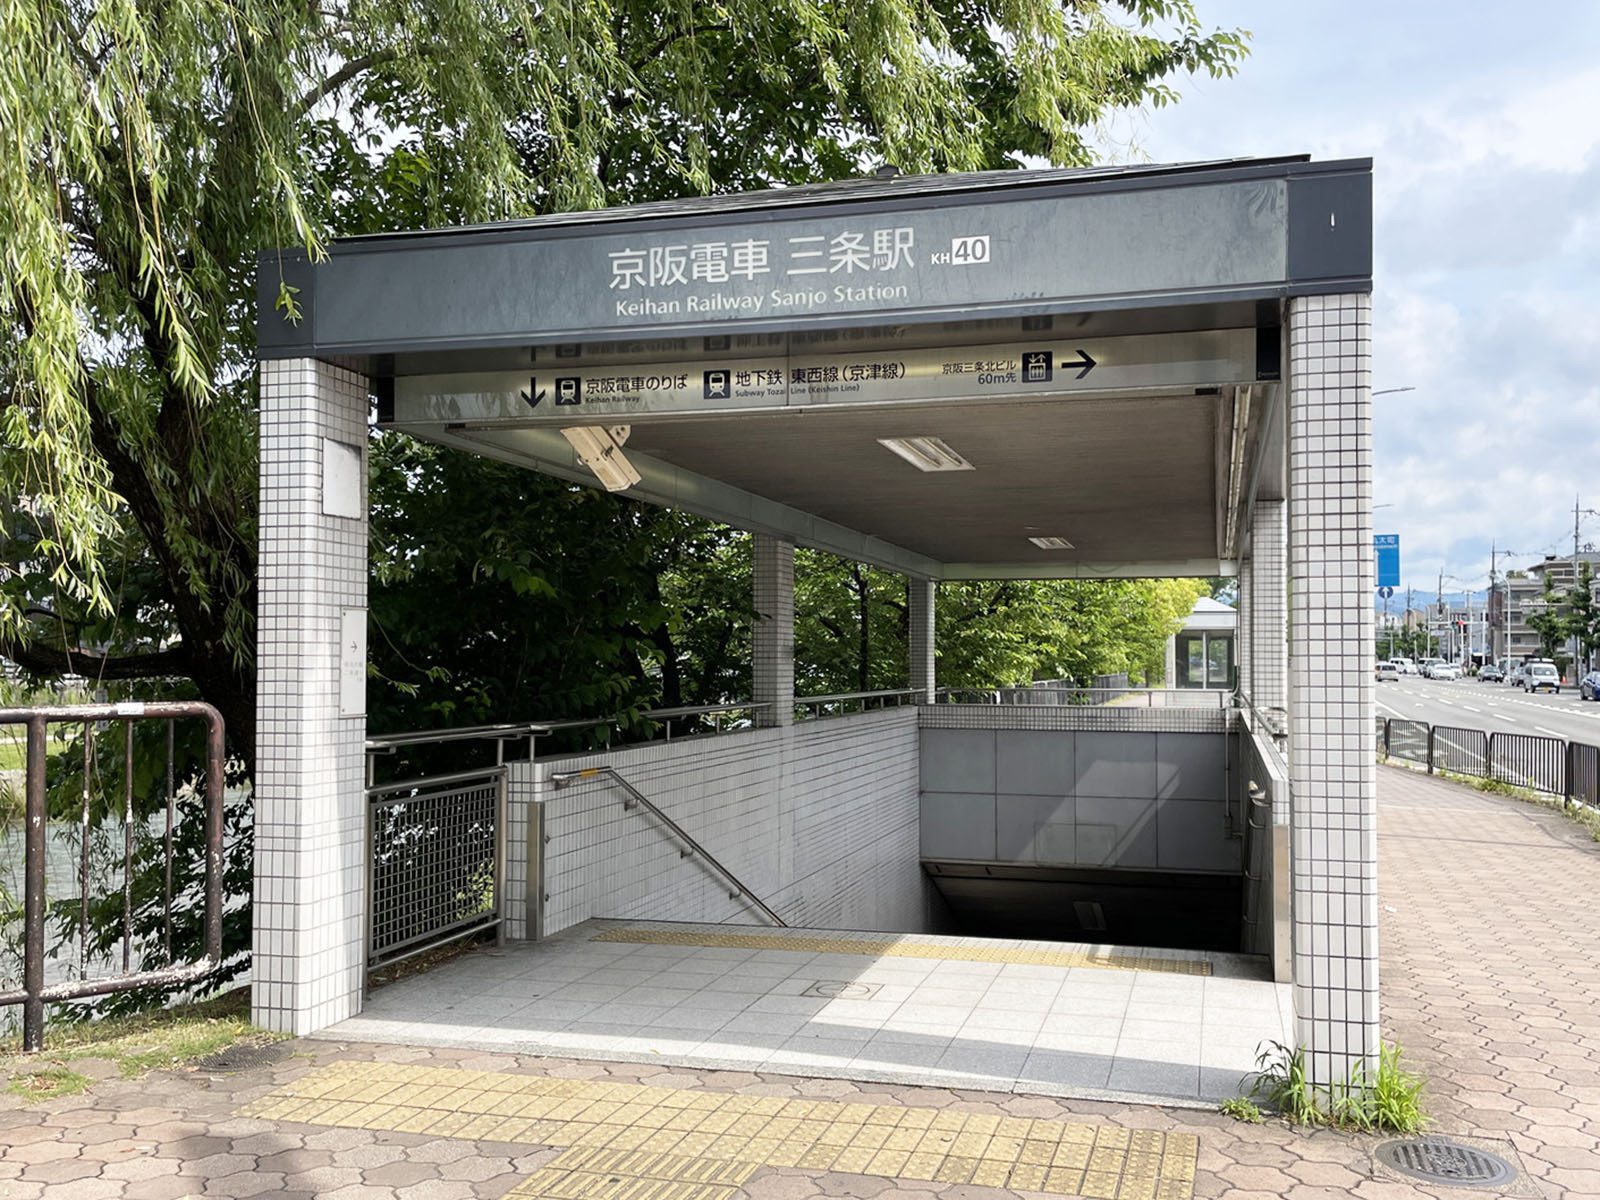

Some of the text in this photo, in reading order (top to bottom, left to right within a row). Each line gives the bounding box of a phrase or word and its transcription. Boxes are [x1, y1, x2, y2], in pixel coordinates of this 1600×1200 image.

[608, 227, 915, 289] 京阪電車 三条駅
[616, 283, 908, 317] Keihan Railway Sanjo Station
[735, 362, 906, 387] 地下鉄 東西線（京津線）
[942, 360, 1017, 375] 京阪三条北ビル
[586, 374, 689, 395] 京阪電車のりば
[978, 372, 1017, 385] 60m先
[586, 394, 641, 404] Keihan Railway
[735, 389, 766, 399] Subway
[790, 386, 806, 395] Line
[808, 384, 839, 394] (Keishin
[841, 383, 861, 393] Line)
